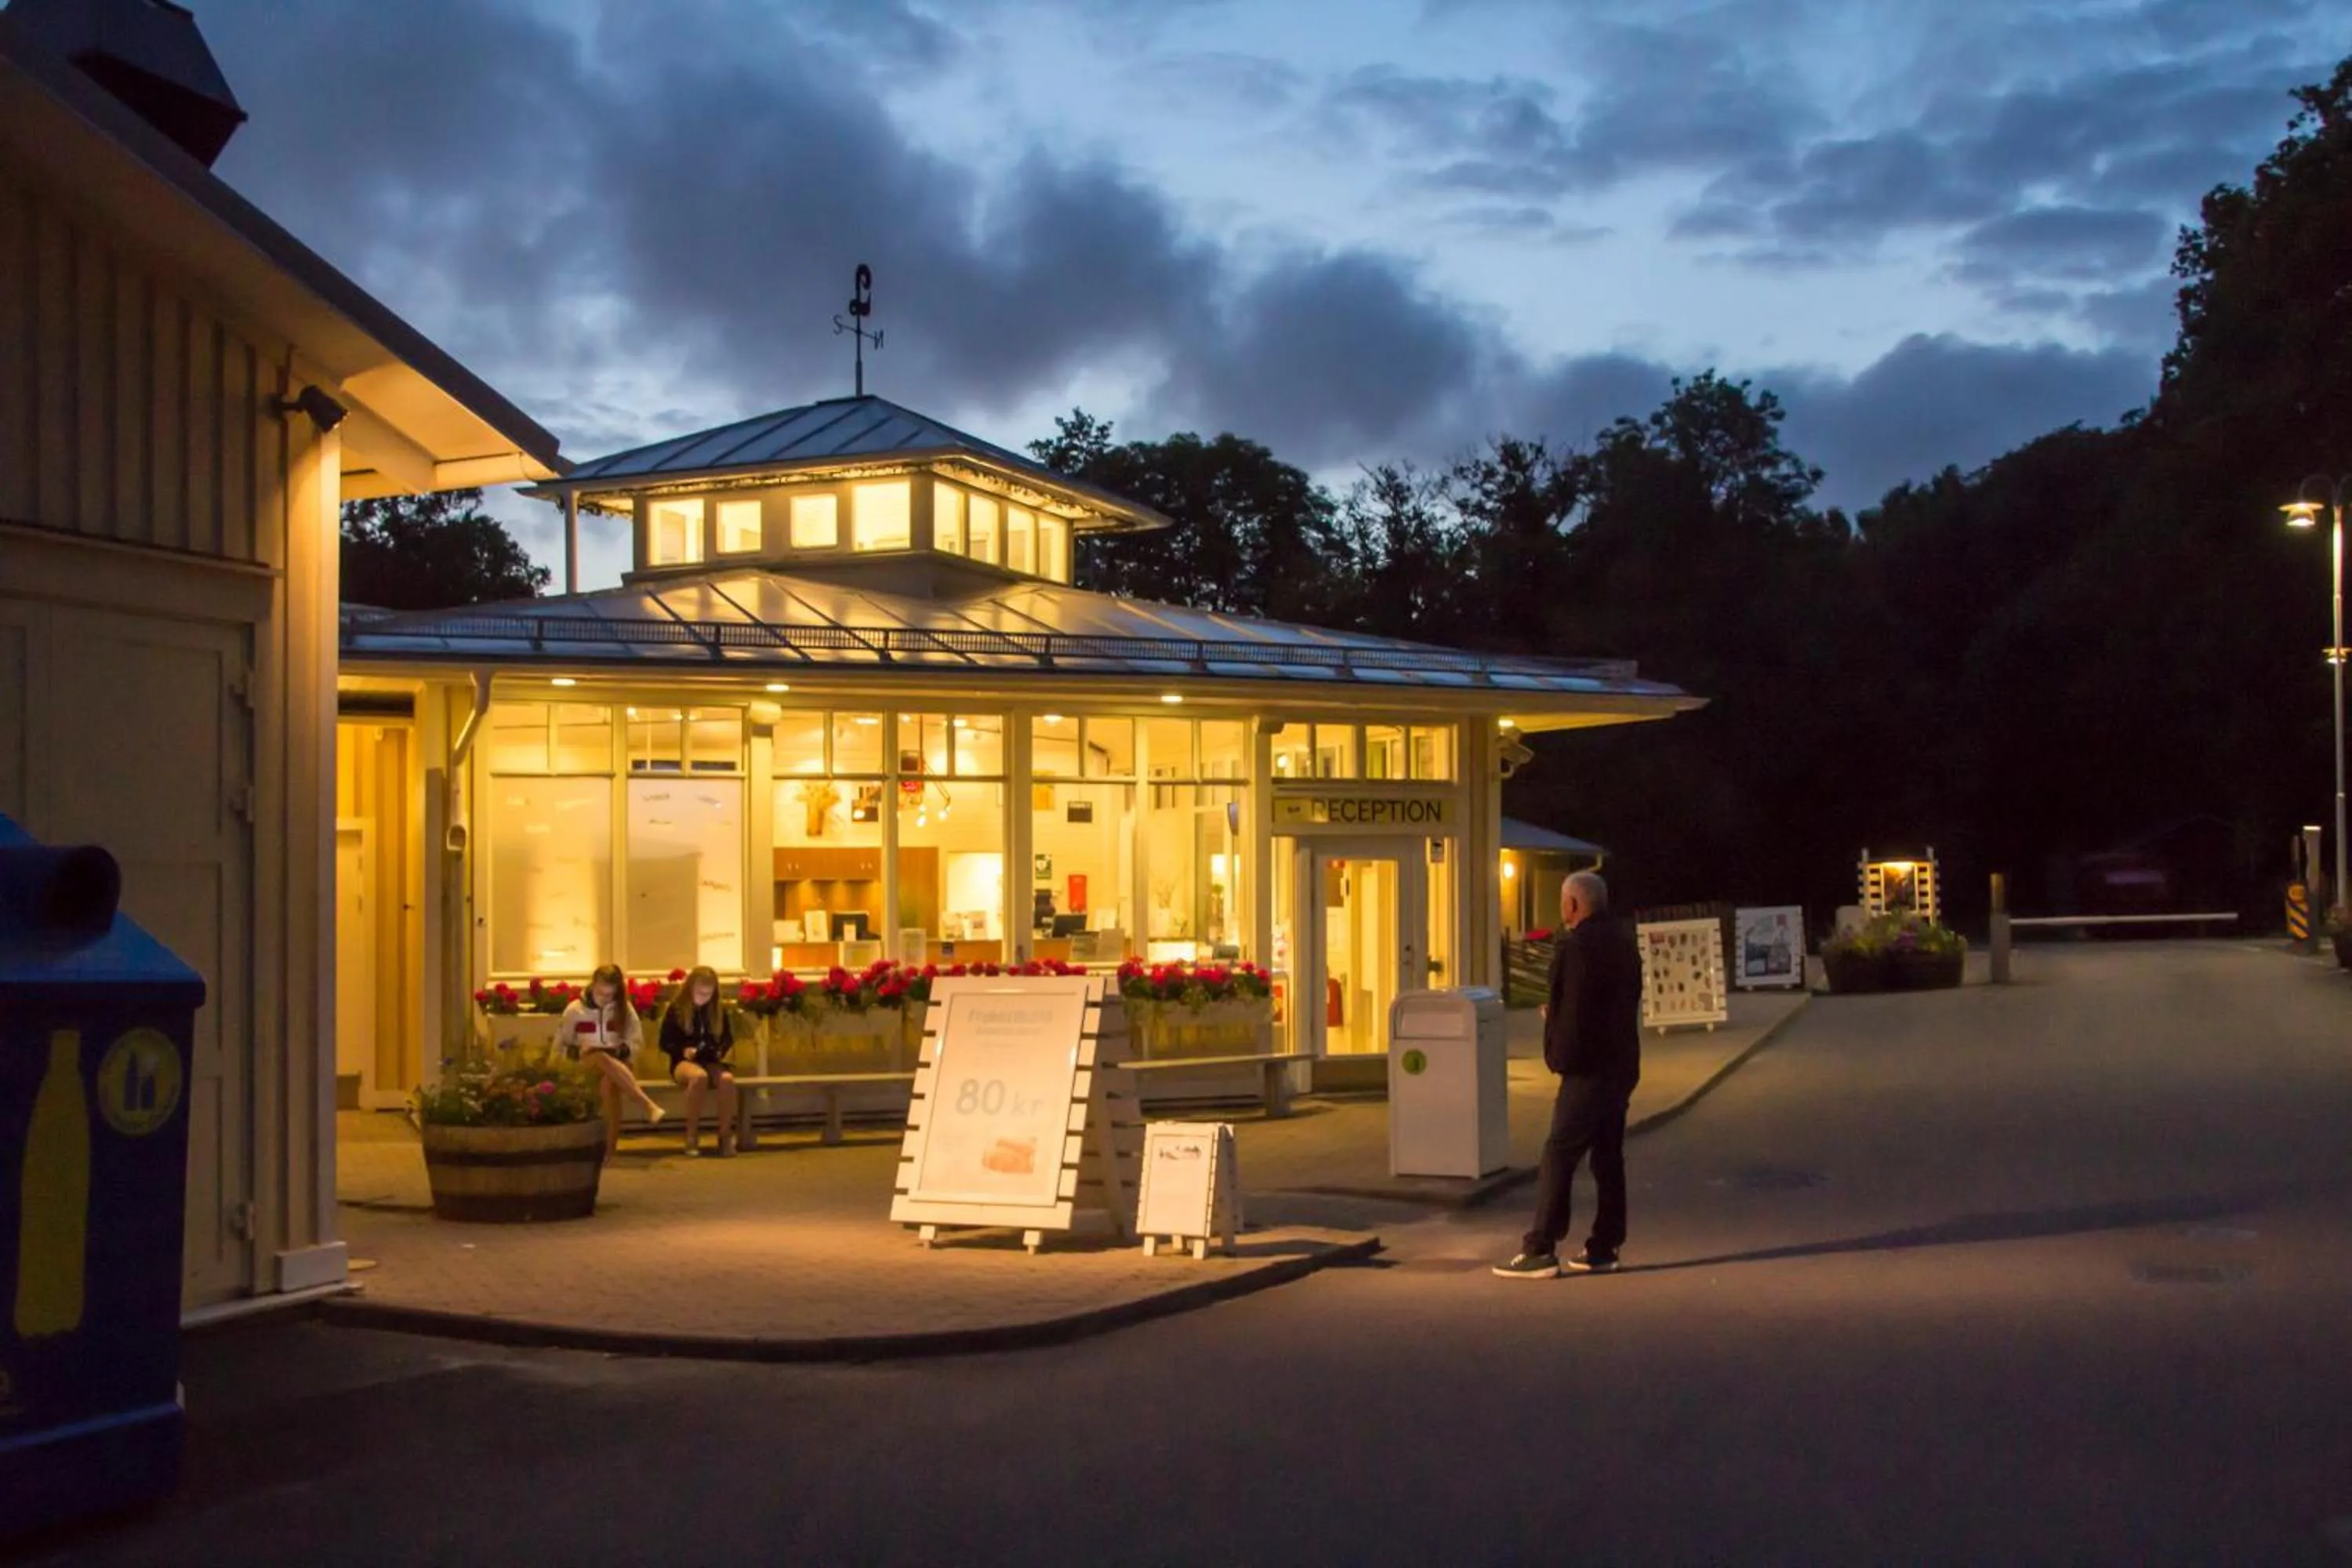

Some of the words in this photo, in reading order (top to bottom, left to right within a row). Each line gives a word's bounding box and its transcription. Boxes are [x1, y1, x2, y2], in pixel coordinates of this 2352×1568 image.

[1312, 799, 1442, 823] RECEPTION
[955, 1078, 1005, 1116] 80
[1011, 1091, 1044, 1117] kr
